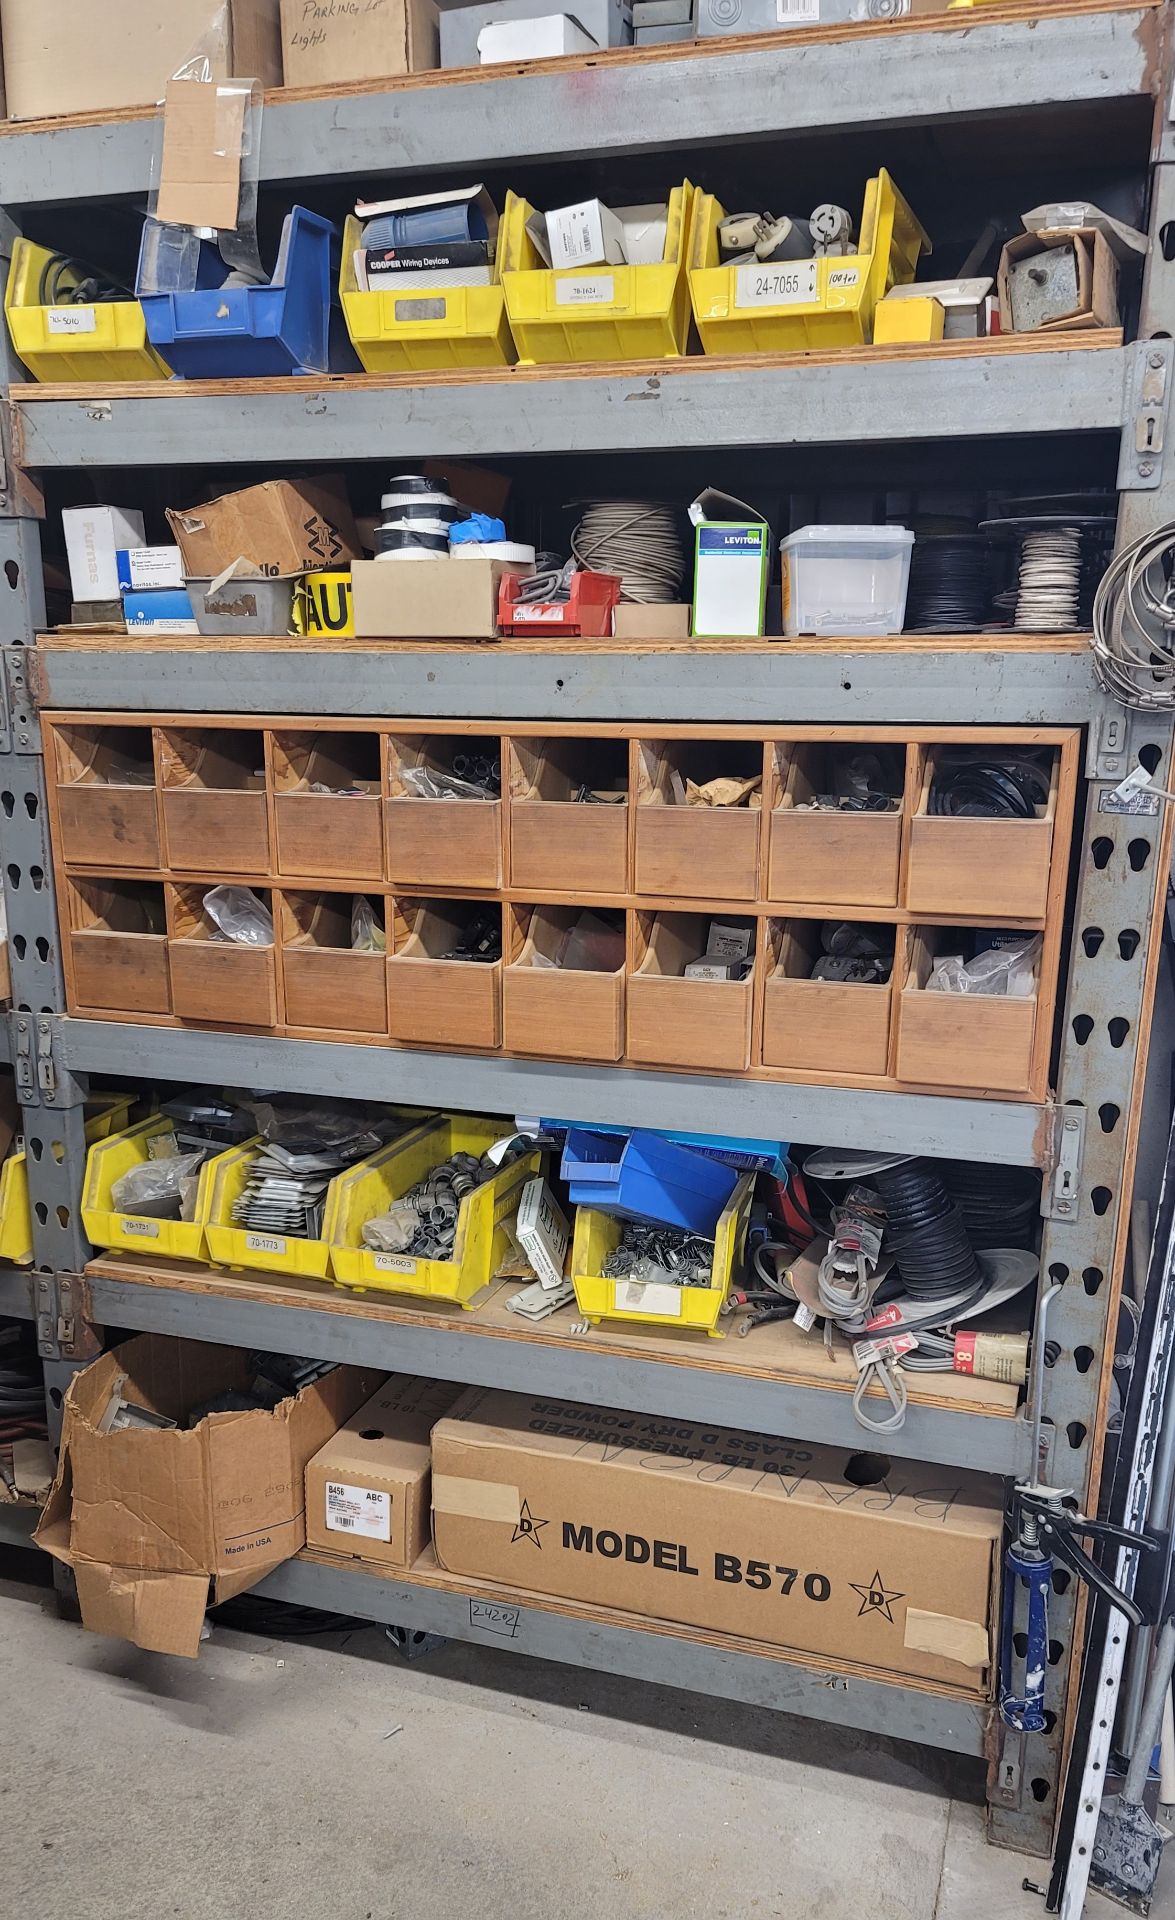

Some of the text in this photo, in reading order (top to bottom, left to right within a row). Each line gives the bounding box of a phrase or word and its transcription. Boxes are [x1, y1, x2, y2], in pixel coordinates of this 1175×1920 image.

[302, 0, 359, 20] PARKING
[291, 28, 327, 51] Lights
[370, 257, 449, 269] COOPER Wiring Devices
[573, 287, 596, 295] 70-1624
[755, 275, 799, 296] 24-7055
[724, 536, 760, 544] LEVITON
[83, 521, 99, 584] Furnas
[307, 582, 351, 631] AU
[125, 1221, 149, 1231] 70-1731
[251, 1237, 278, 1249] 70-1773
[376, 1256, 412, 1267] 70-5003
[956, 1351, 973, 1362] 8
[531, 1401, 637, 1430] POWDER
[643, 1420, 695, 1439] DRY
[701, 1433, 720, 1445] D
[528, 1419, 796, 1477] 30 LB. PRESSURIZED
[727, 1437, 814, 1463] CLASS
[328, 1485, 383, 1502] B456 ABC
[225, 1536, 272, 1555] Made in USA
[561, 1521, 699, 1576] MODEL
[714, 1552, 831, 1602] B570
[473, 1604, 521, 1627] 24202
